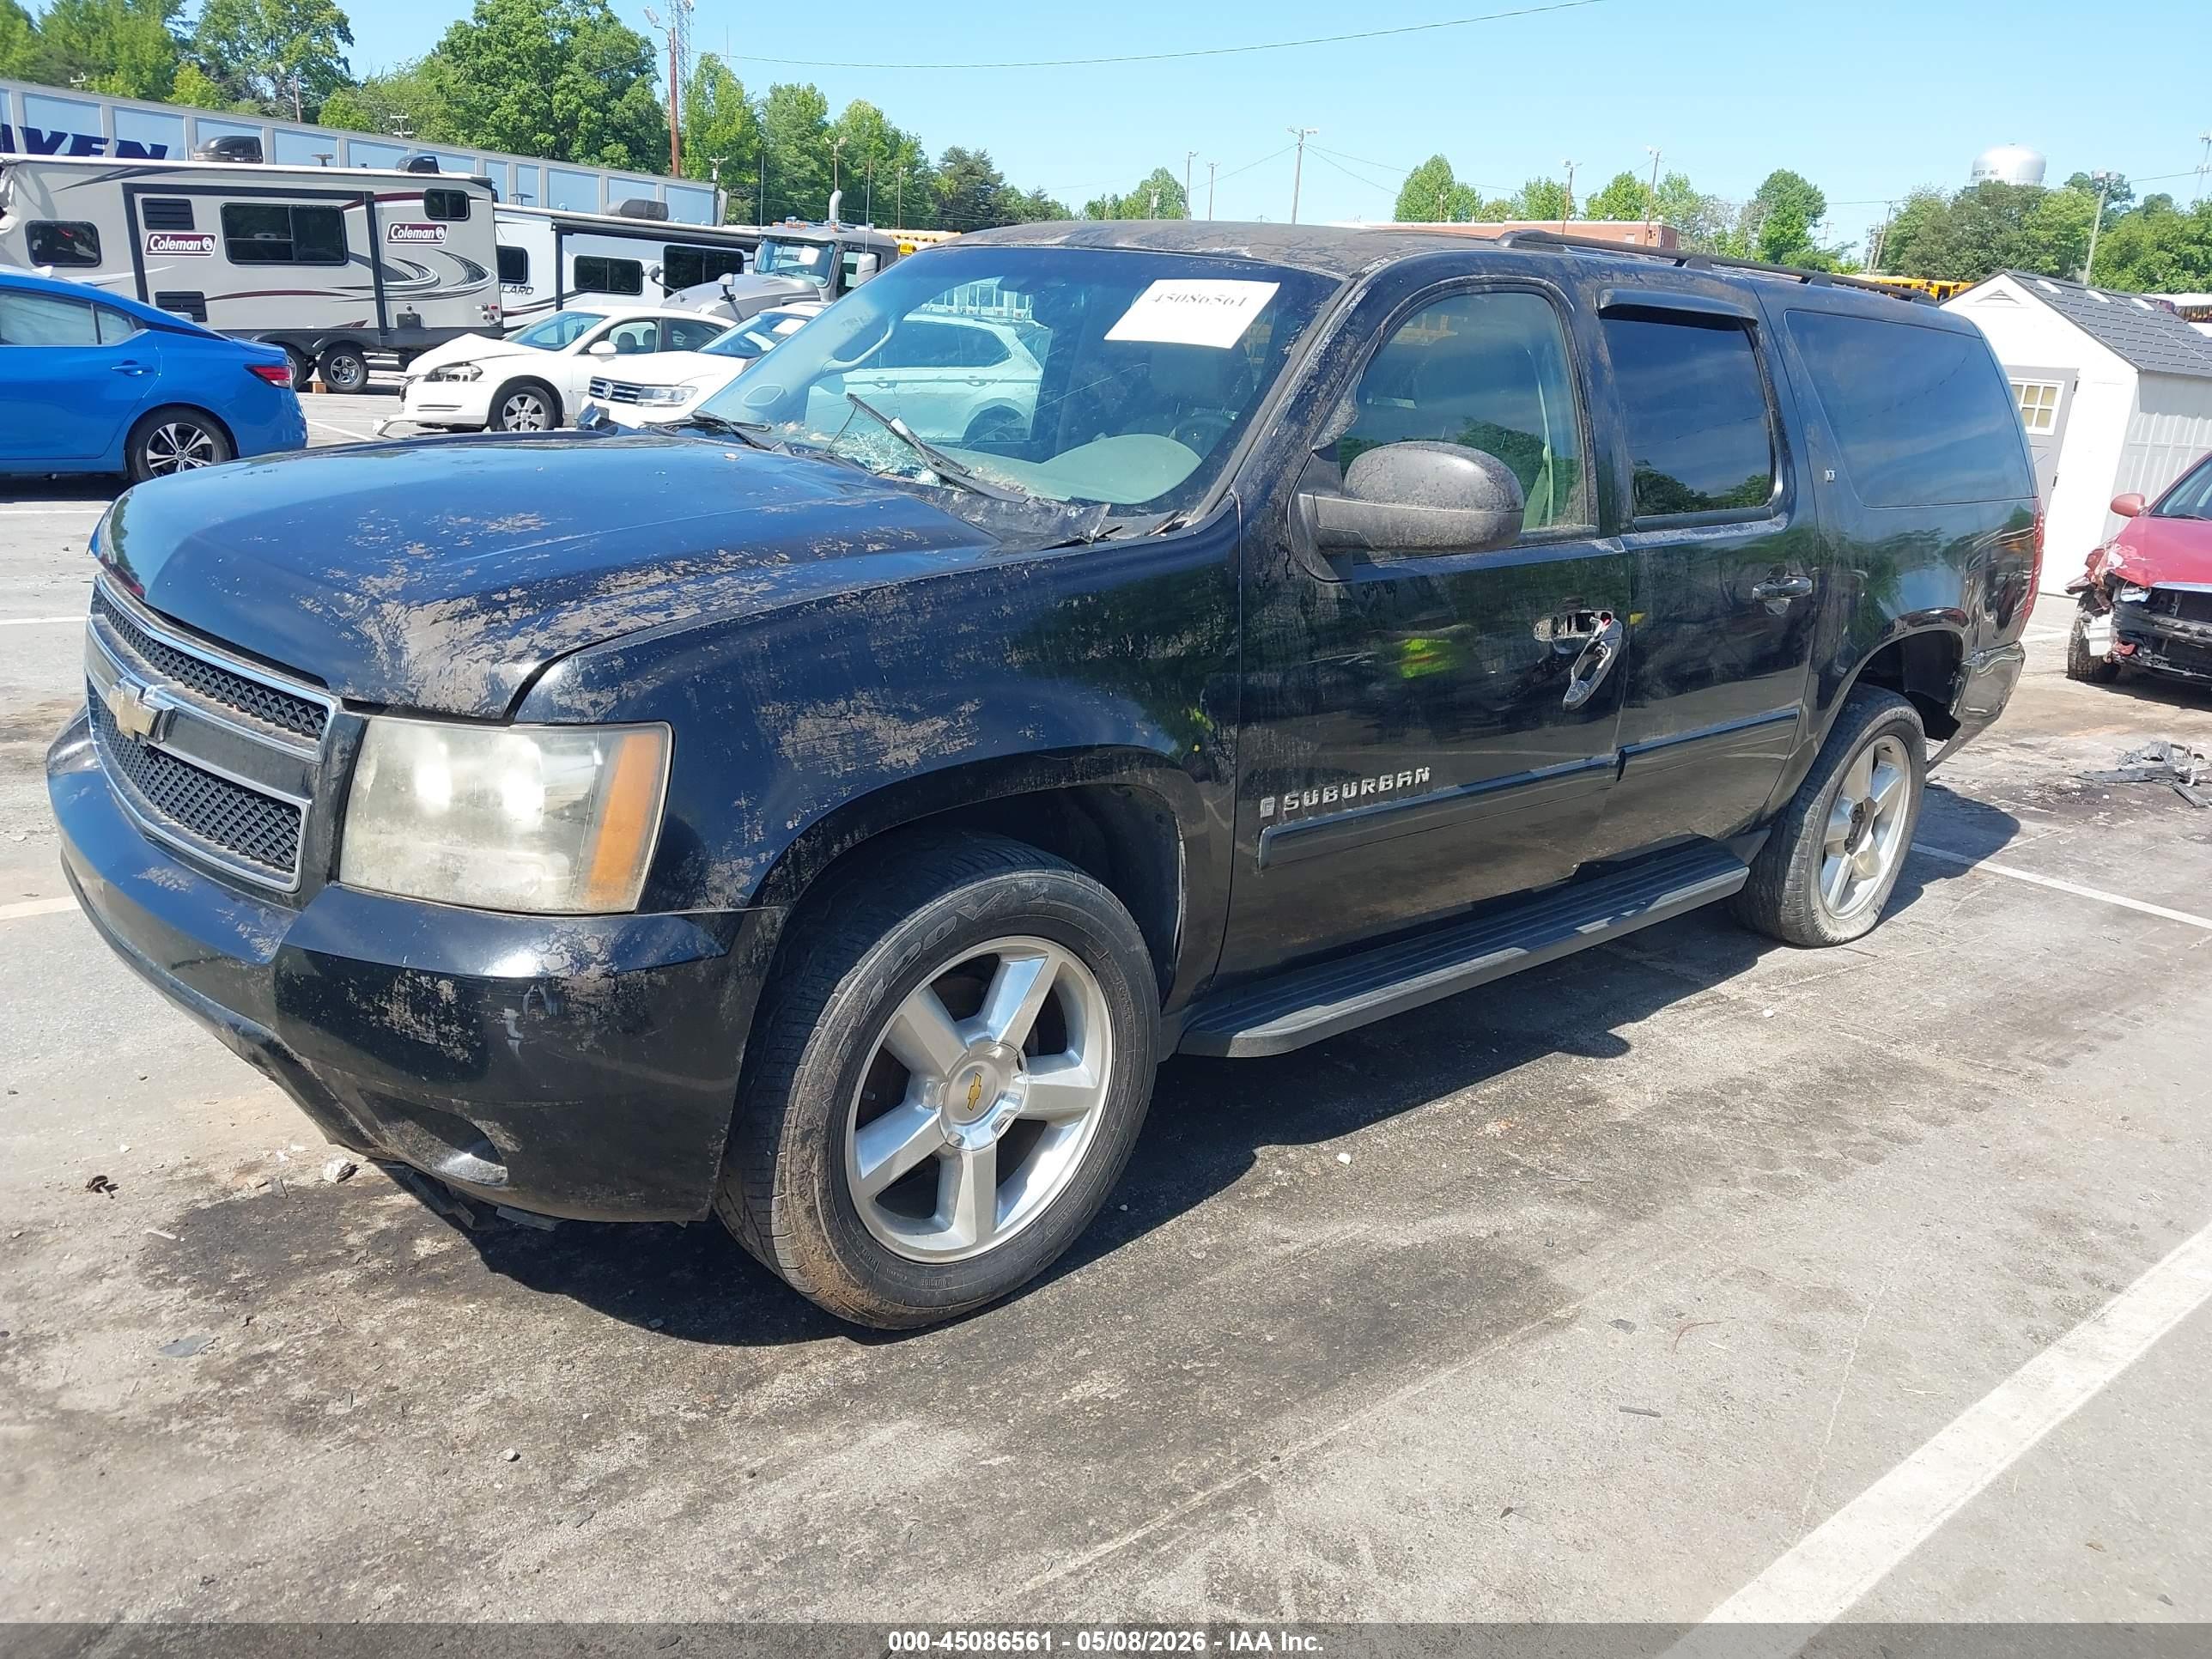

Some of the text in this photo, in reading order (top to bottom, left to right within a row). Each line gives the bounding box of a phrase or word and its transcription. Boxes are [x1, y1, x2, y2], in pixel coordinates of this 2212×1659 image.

[390, 224, 434, 240] Coleman
[149, 234, 202, 251] Coleman
[1283, 766, 1431, 812] SUBURBAN
